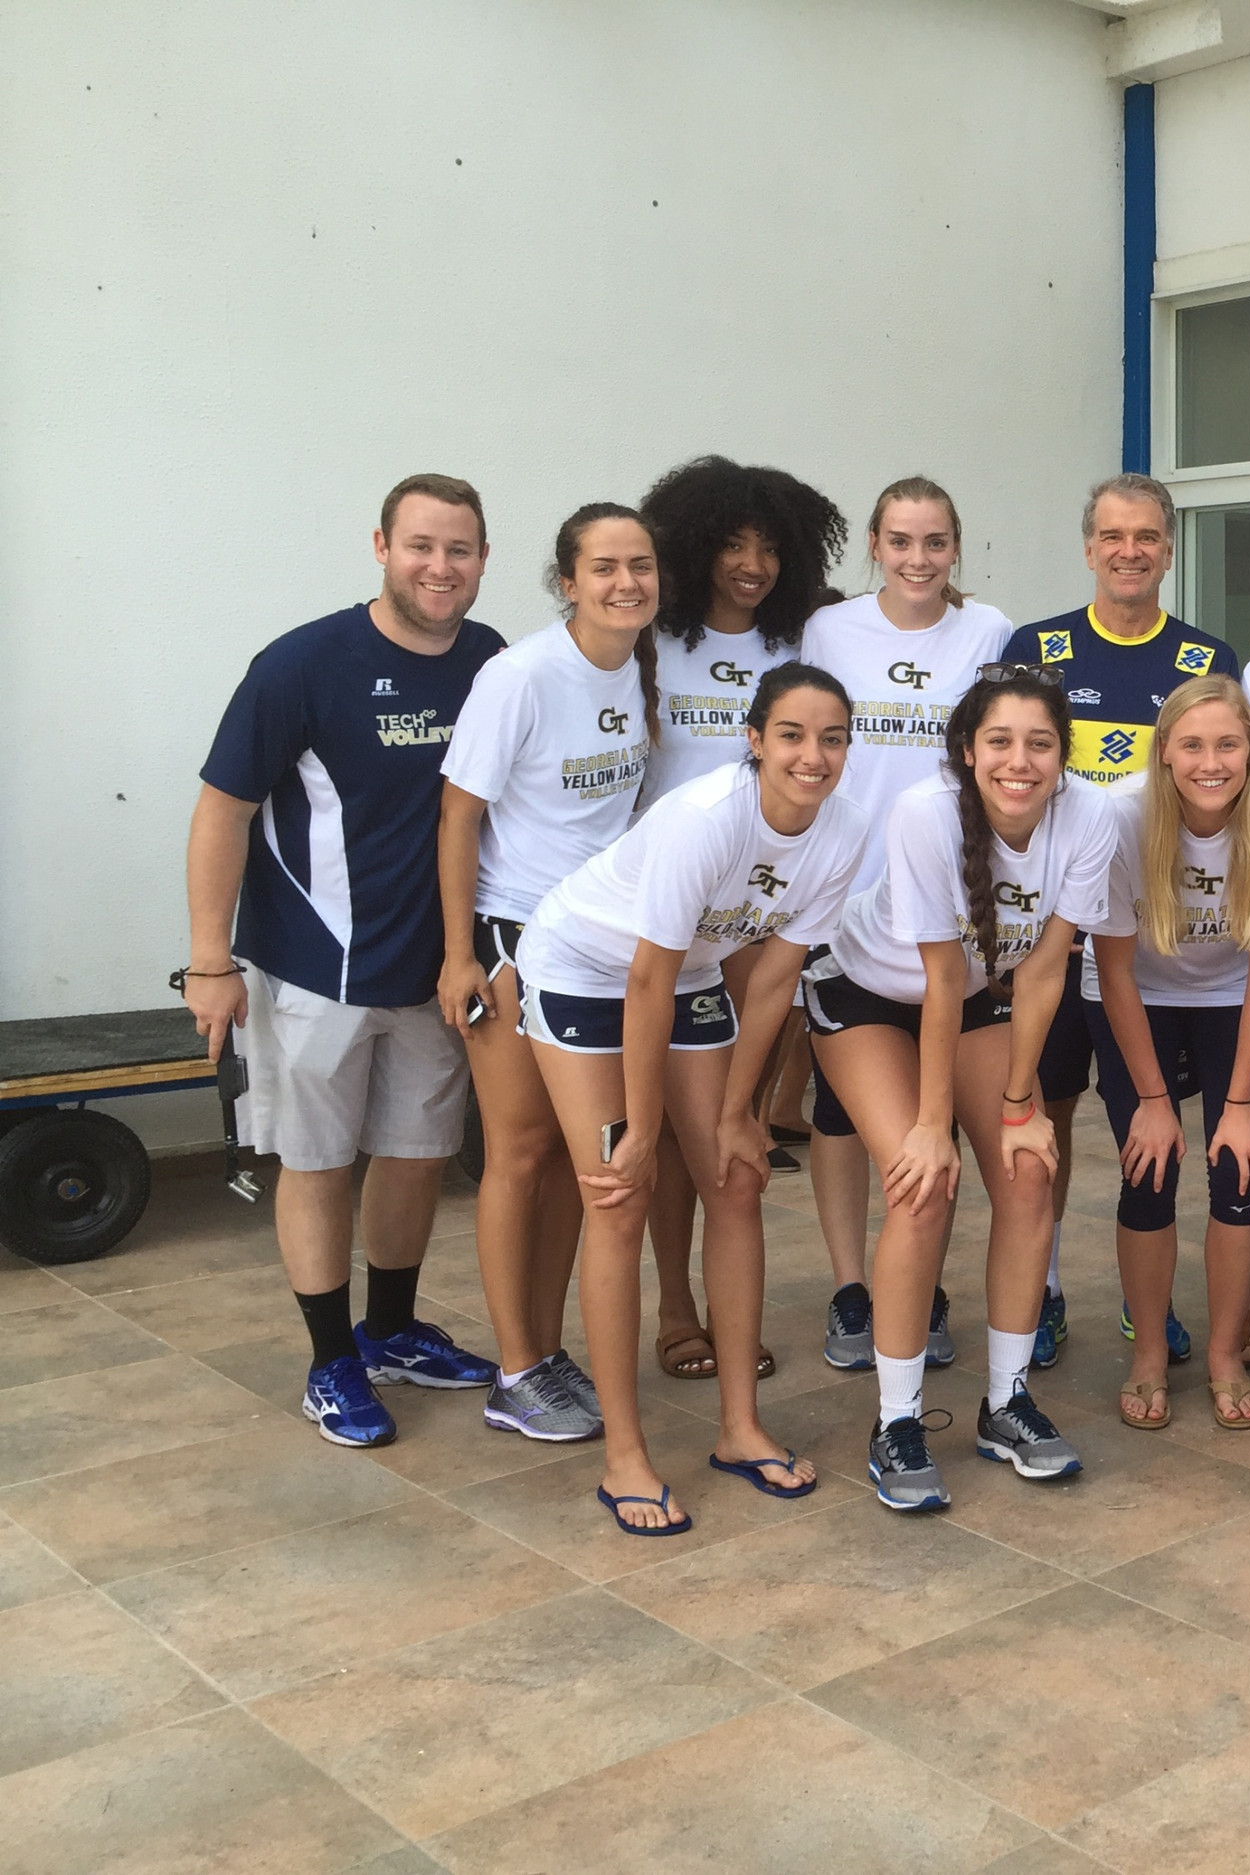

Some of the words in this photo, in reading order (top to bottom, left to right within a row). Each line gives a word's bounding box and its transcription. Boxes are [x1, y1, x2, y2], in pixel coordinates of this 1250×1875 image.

[709, 661, 753, 687] GT
[888, 661, 932, 690] GT
[668, 694, 752, 711] GEORGIA
[929, 703, 957, 721] TE
[375, 713, 426, 730] TECH
[598, 706, 629, 736] GT
[670, 710, 734, 726] YELLOW
[908, 720, 948, 736] JACK
[377, 724, 455, 747] VOLLEY
[562, 747, 630, 775] GEORGIA
[561, 767, 616, 790] YELLOW
[993, 881, 1041, 913] GT
